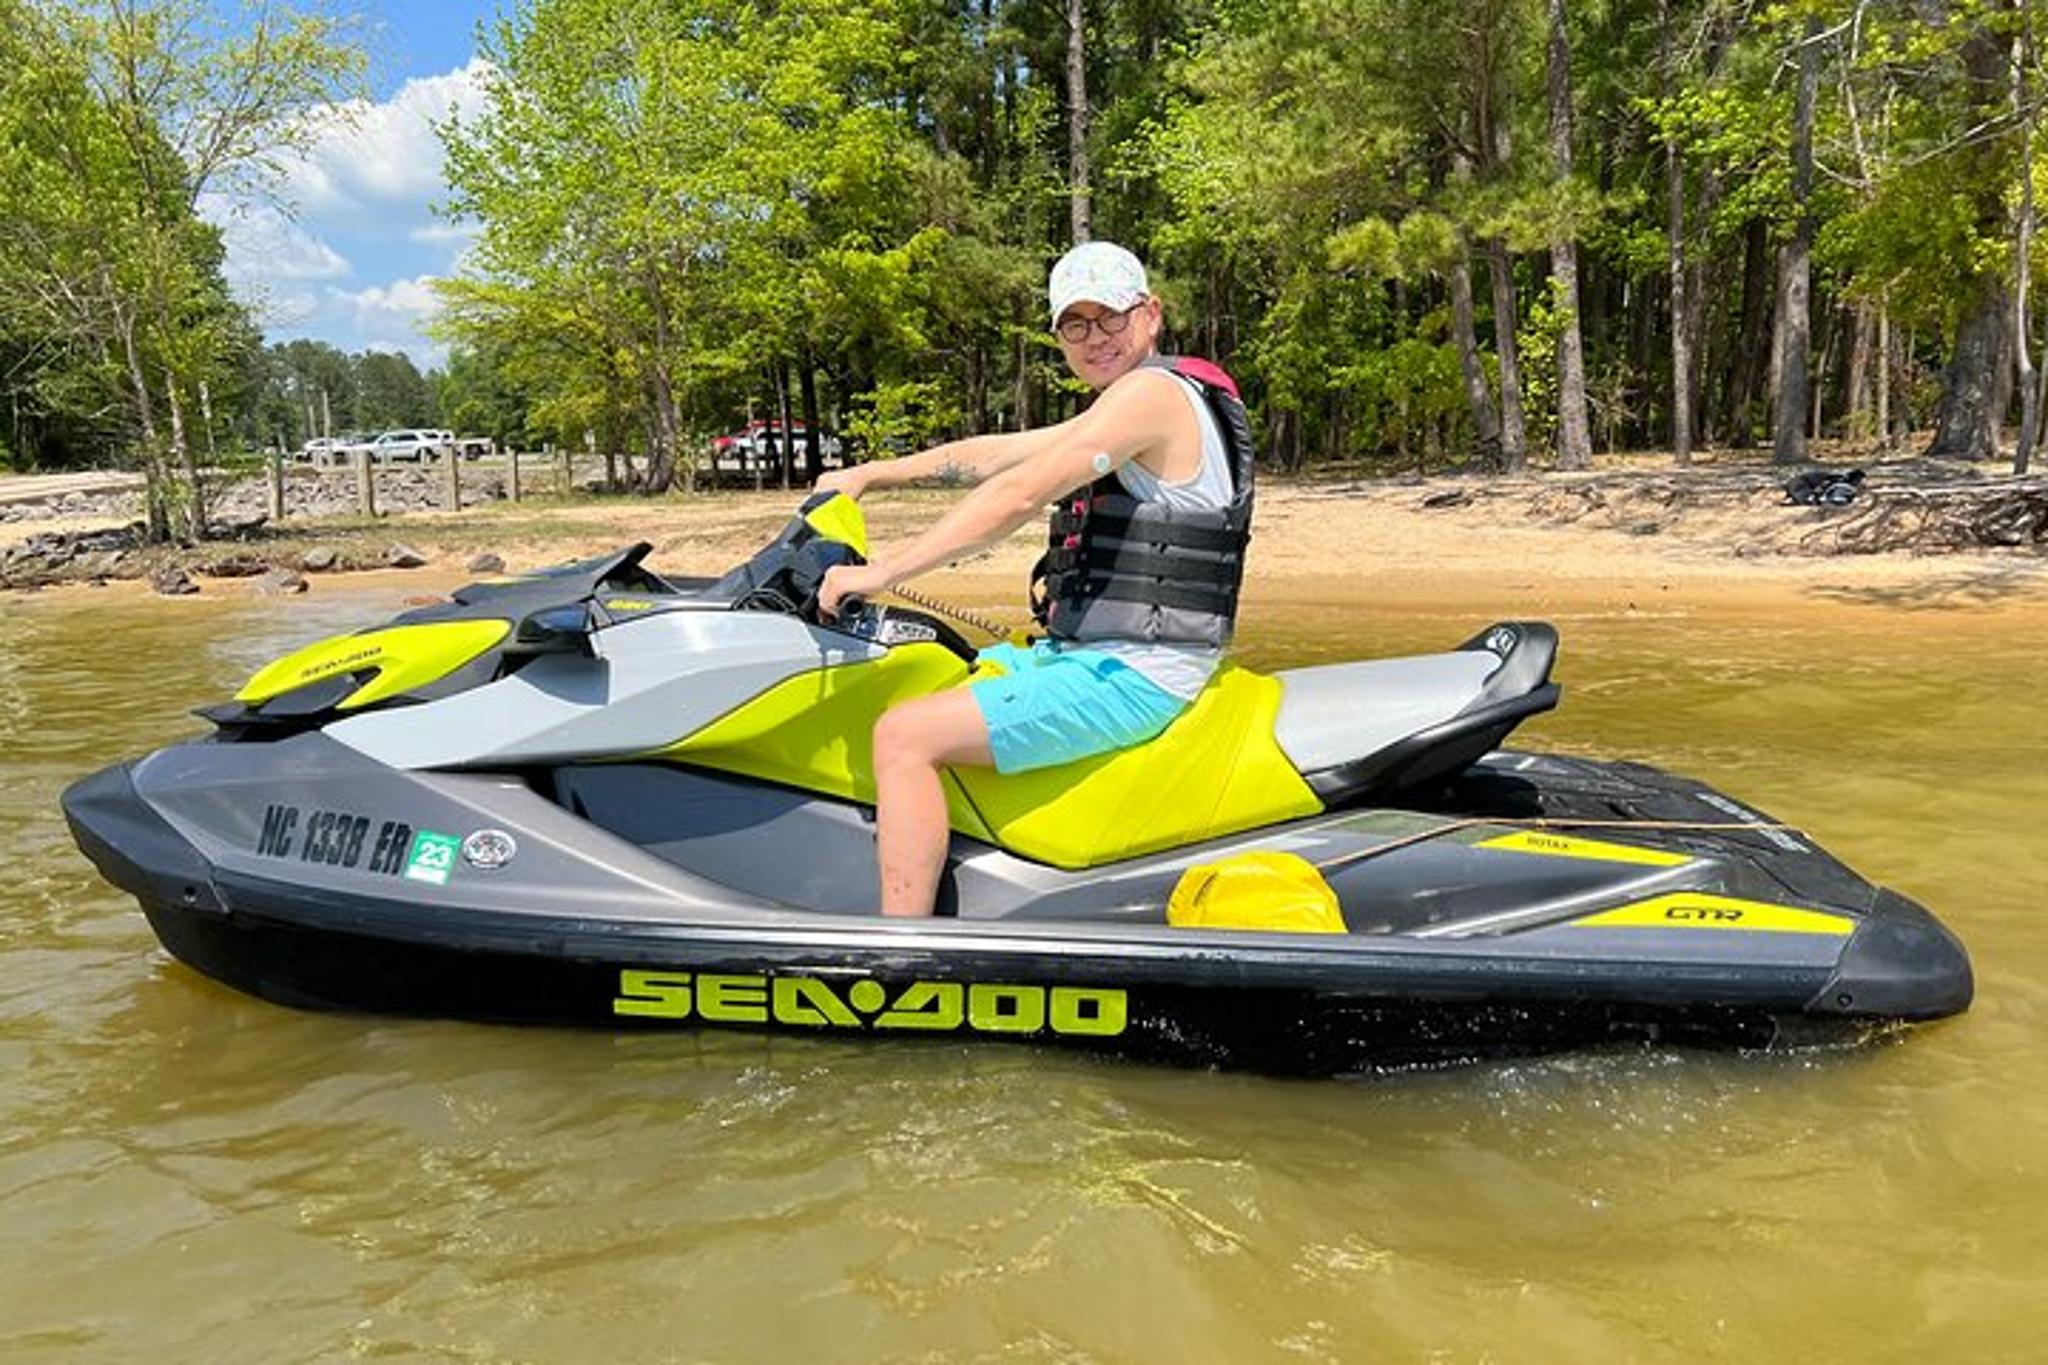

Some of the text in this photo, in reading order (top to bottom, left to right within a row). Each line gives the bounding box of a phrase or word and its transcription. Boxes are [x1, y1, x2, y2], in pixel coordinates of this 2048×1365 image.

[257, 804, 299, 858] NC
[301, 810, 370, 868] 1338
[369, 820, 413, 876] ER
[415, 841, 452, 867] 23
[1664, 906, 1744, 921] GTR
